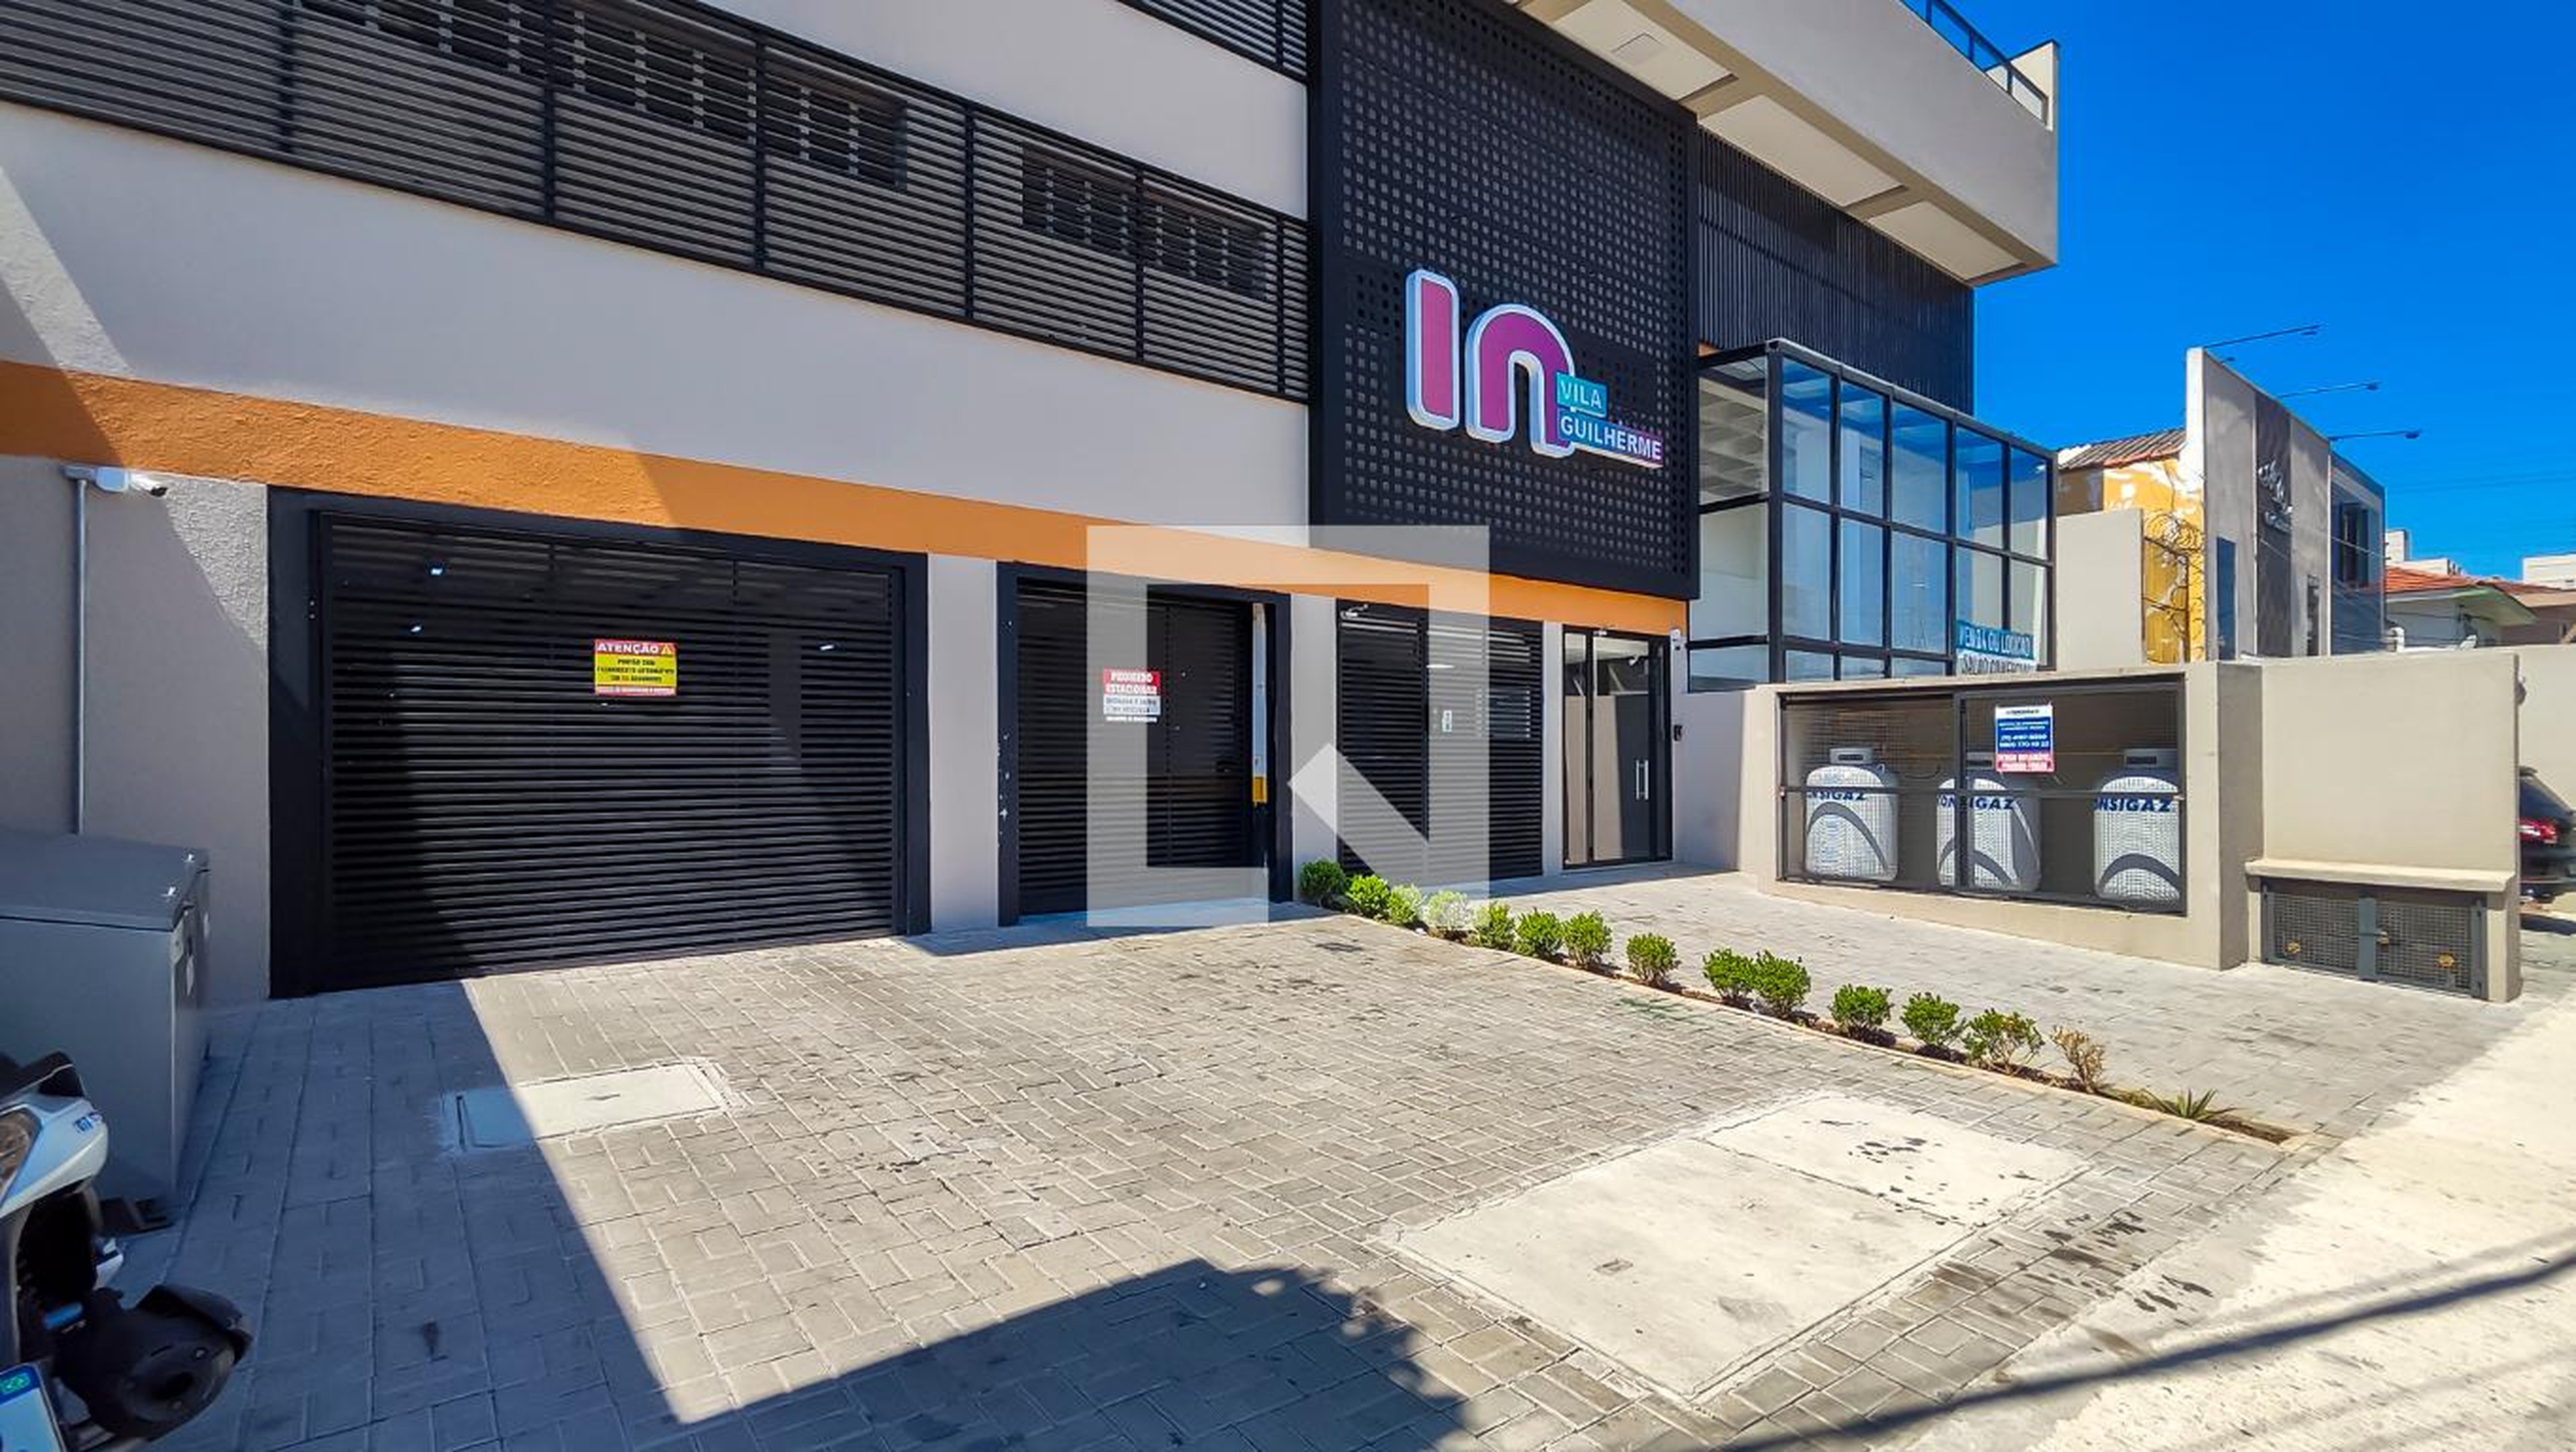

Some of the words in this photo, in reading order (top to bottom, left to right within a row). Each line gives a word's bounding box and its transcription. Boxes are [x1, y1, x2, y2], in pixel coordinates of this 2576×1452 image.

[1560, 379, 1603, 409] VILA
[1560, 415, 1662, 460] GUILHERME
[596, 642, 659, 654] ATENÇÃO
